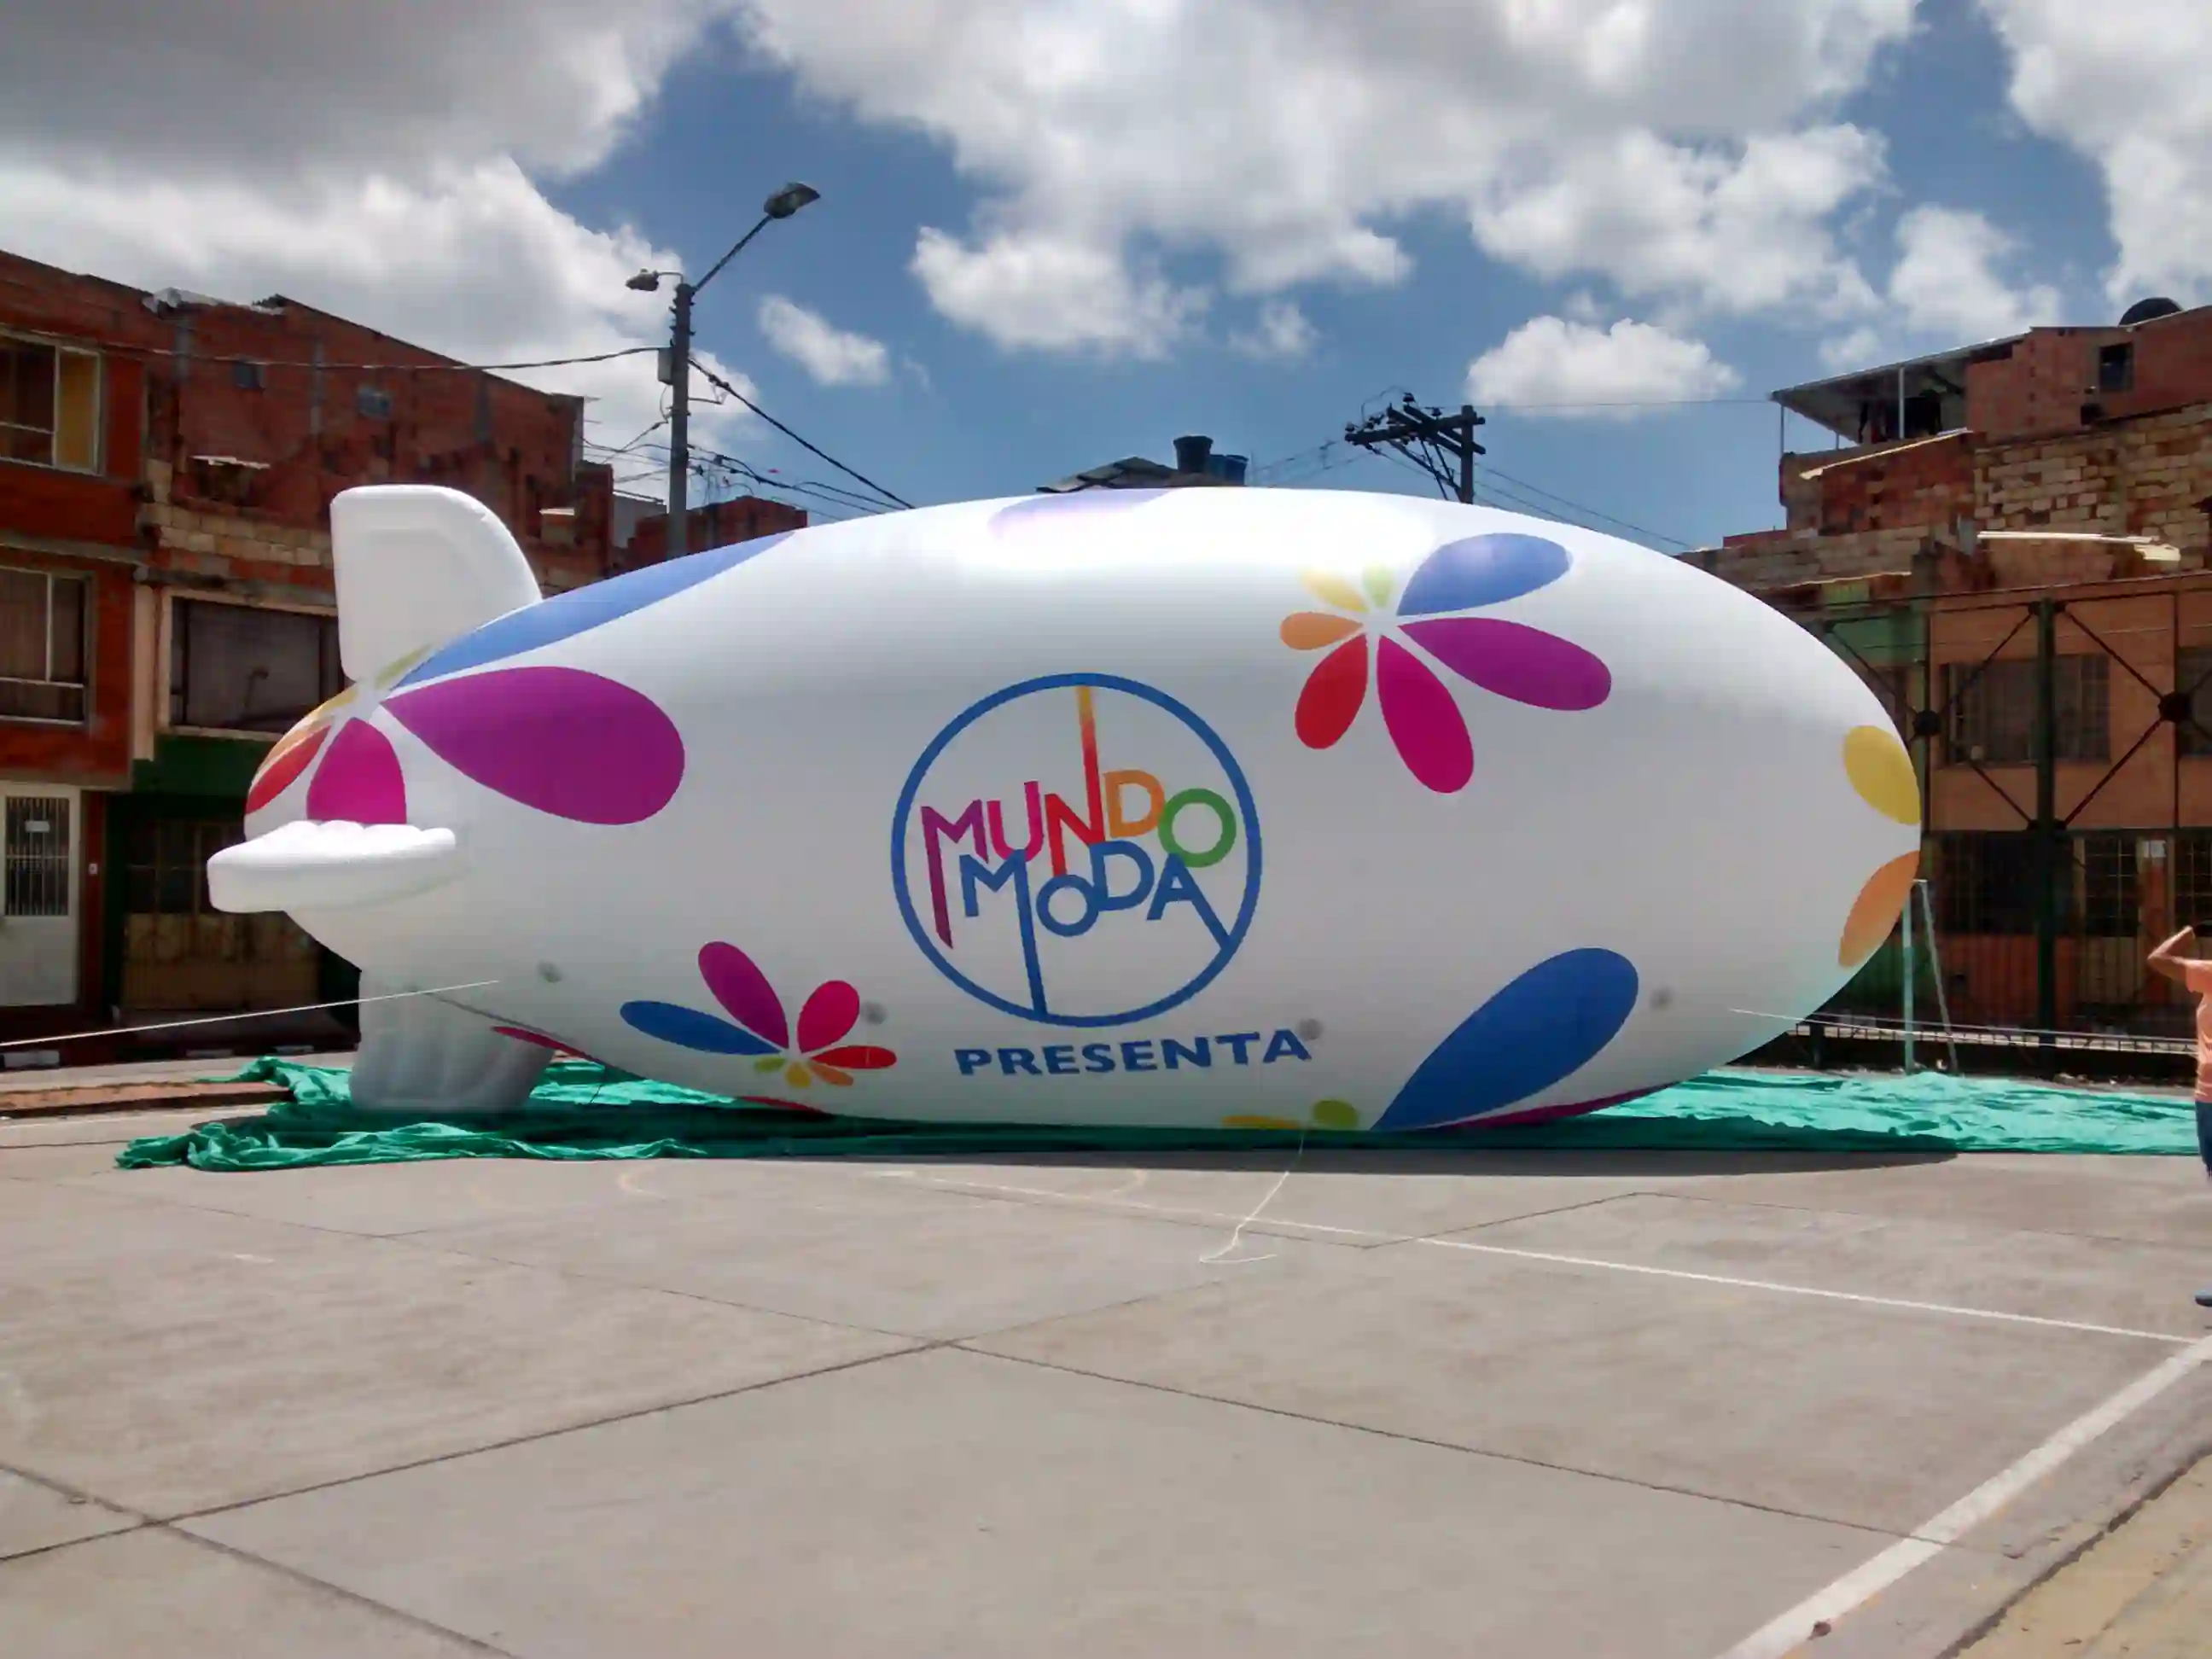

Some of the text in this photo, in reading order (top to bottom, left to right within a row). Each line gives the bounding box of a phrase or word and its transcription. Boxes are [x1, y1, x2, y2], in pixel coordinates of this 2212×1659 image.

[921, 685, 1237, 949] MUNDO
[959, 840, 1229, 1014] MODA
[954, 1029, 1312, 1075] PRESENTA
